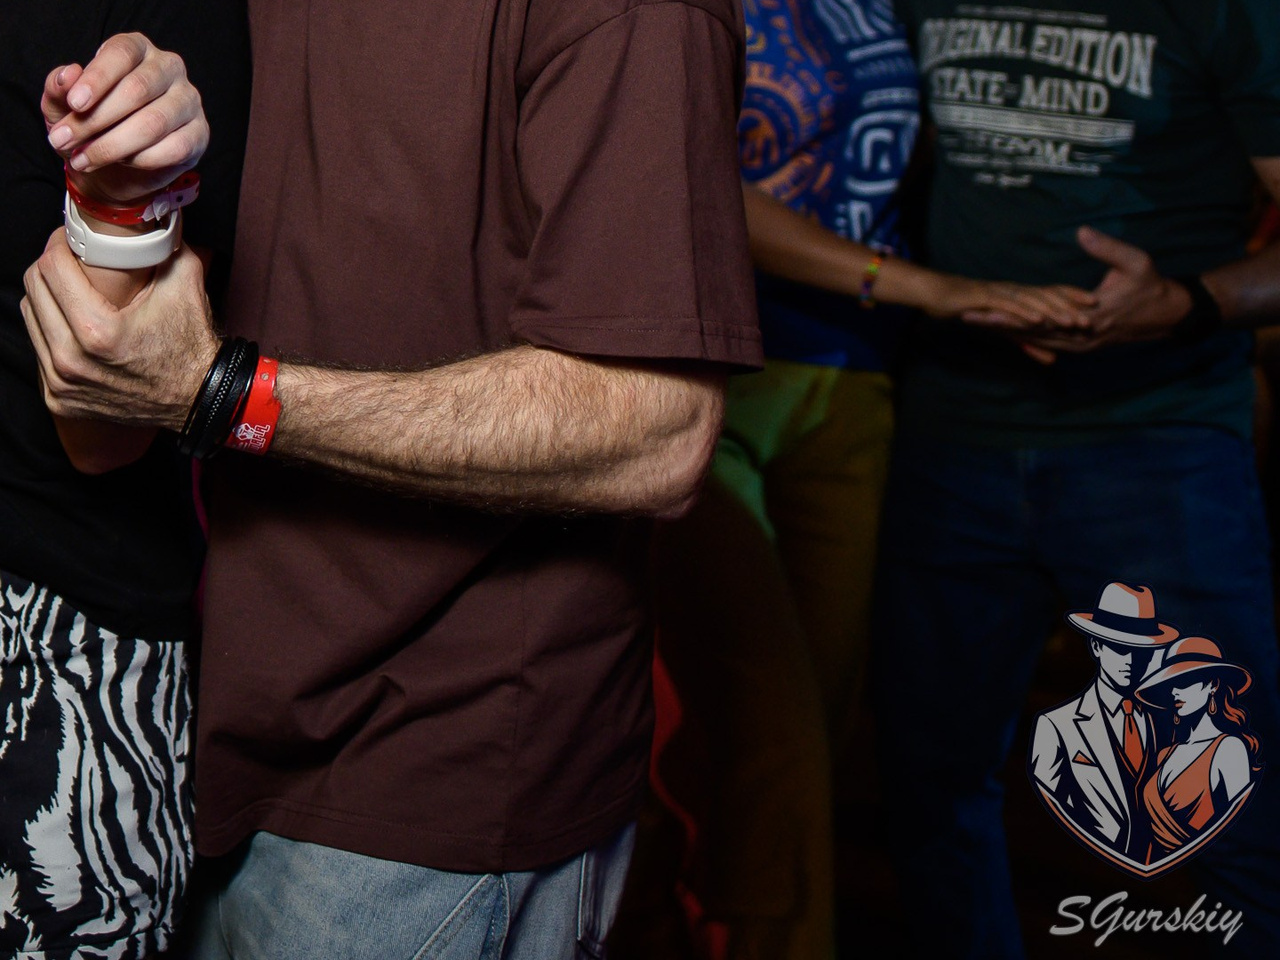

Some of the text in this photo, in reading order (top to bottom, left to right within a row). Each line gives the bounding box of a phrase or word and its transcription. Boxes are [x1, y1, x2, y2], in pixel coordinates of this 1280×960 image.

[931, 66, 1009, 105] STATE
[1017, 73, 1111, 117] MIND
[1029, 23, 1157, 100] EDITION
